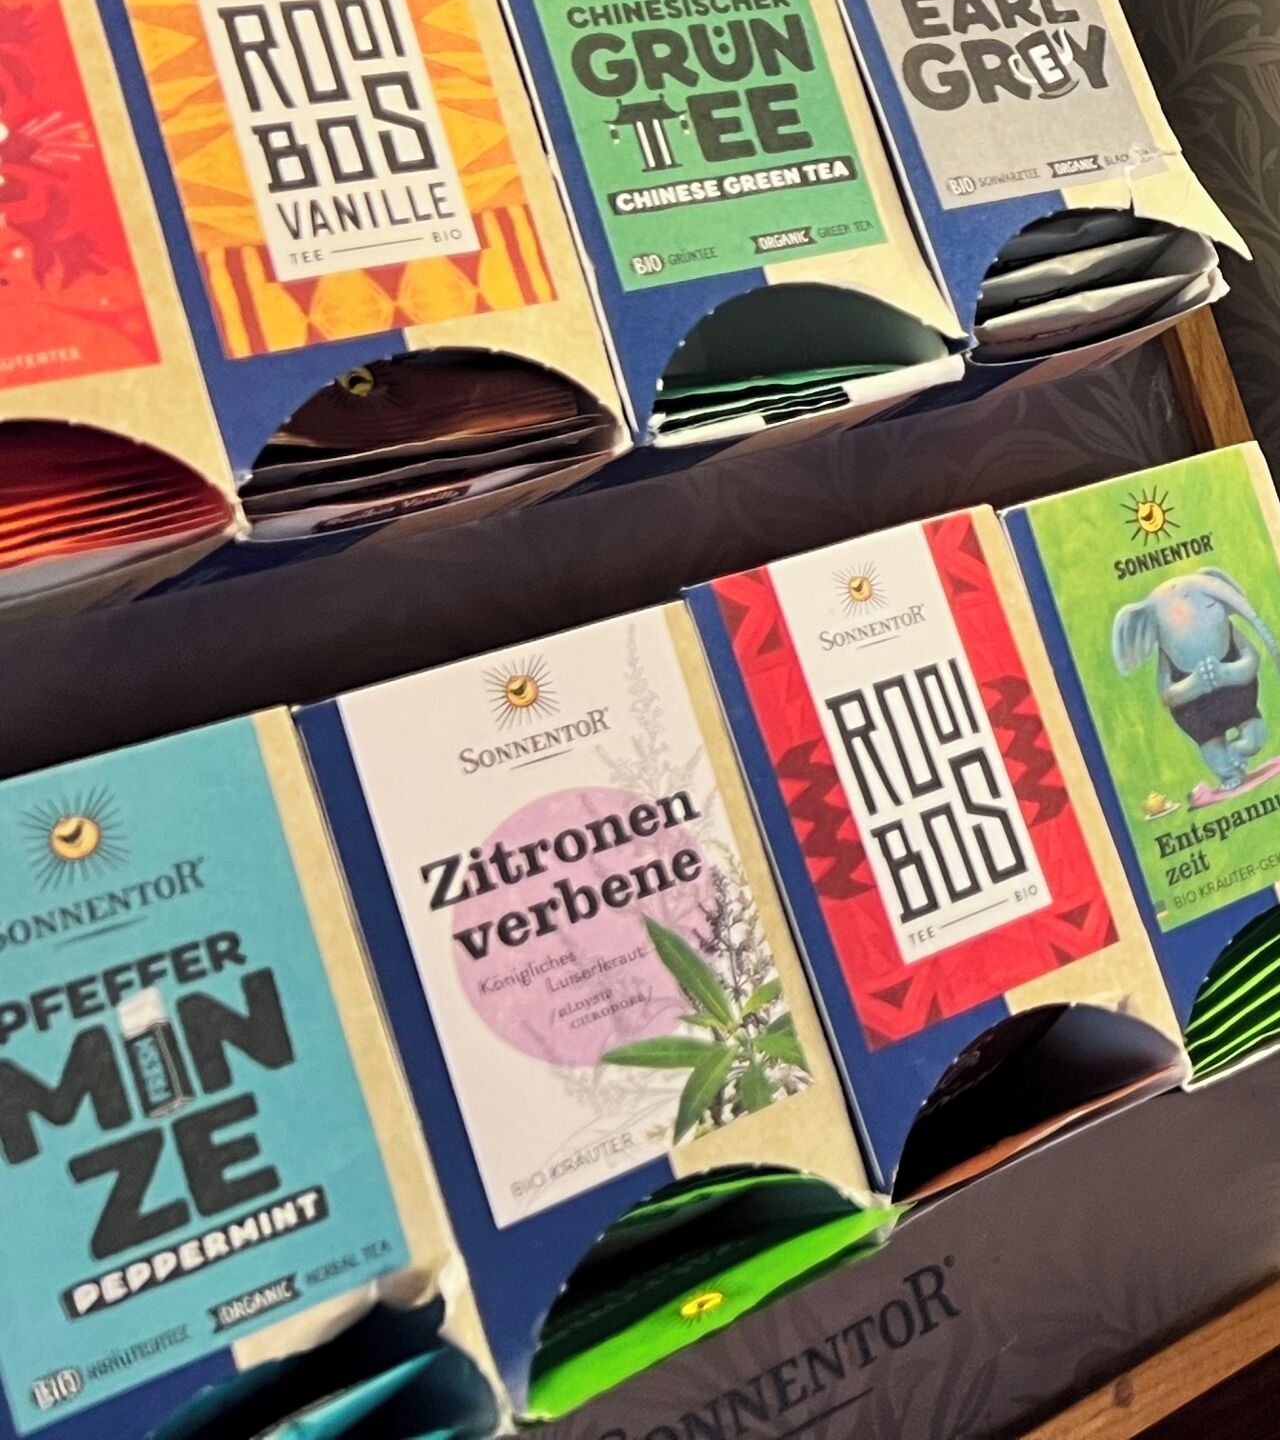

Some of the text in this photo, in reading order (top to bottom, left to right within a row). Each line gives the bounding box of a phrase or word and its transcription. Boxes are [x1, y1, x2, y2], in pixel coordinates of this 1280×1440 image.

[571, 13, 816, 98] GRÜN
[902, 24, 1109, 111] GREY
[251, 70, 440, 194] BOS
[603, 83, 814, 173] TEE
[615, 159, 850, 212] CHINESE GREEN TEA
[948, 177, 975, 196] BIO
[978, 167, 1041, 188] SCHWARZTEE
[1055, 156, 1099, 175] ORGANIC
[276, 181, 456, 240] VANILLE
[756, 219, 875, 251] ORGANIC GREEN TEA
[289, 228, 463, 266] TEE BIO
[631, 246, 718, 276] BIO GRÜNTEE
[1113, 533, 1214, 580] SONNENTOR
[819, 604, 926, 652] SONNENTOR
[459, 707, 611, 775] SONNENTOR
[824, 657, 981, 816] ROOI
[420, 790, 701, 912] Zitronen
[870, 746, 1029, 924] BOS
[1165, 850, 1211, 887] zeit
[453, 848, 702, 960] verbene
[907, 884, 1038, 947] TEE BIO
[1173, 888, 1198, 910] BIO
[0, 931, 248, 1044] PFEFFER
[480, 951, 577, 996] Königliches
[0, 966, 296, 1166] MIN
[68, 1092, 281, 1260] ZE
[510, 1172, 546, 1199] BIO
[71, 1190, 319, 1316] PEPPERMINT
[33, 1368, 81, 1410] BIO
[218, 1280, 293, 1326] ORGANIC
[306, 1255, 361, 1285] HERBAL
[361, 1238, 392, 1262] TEA
